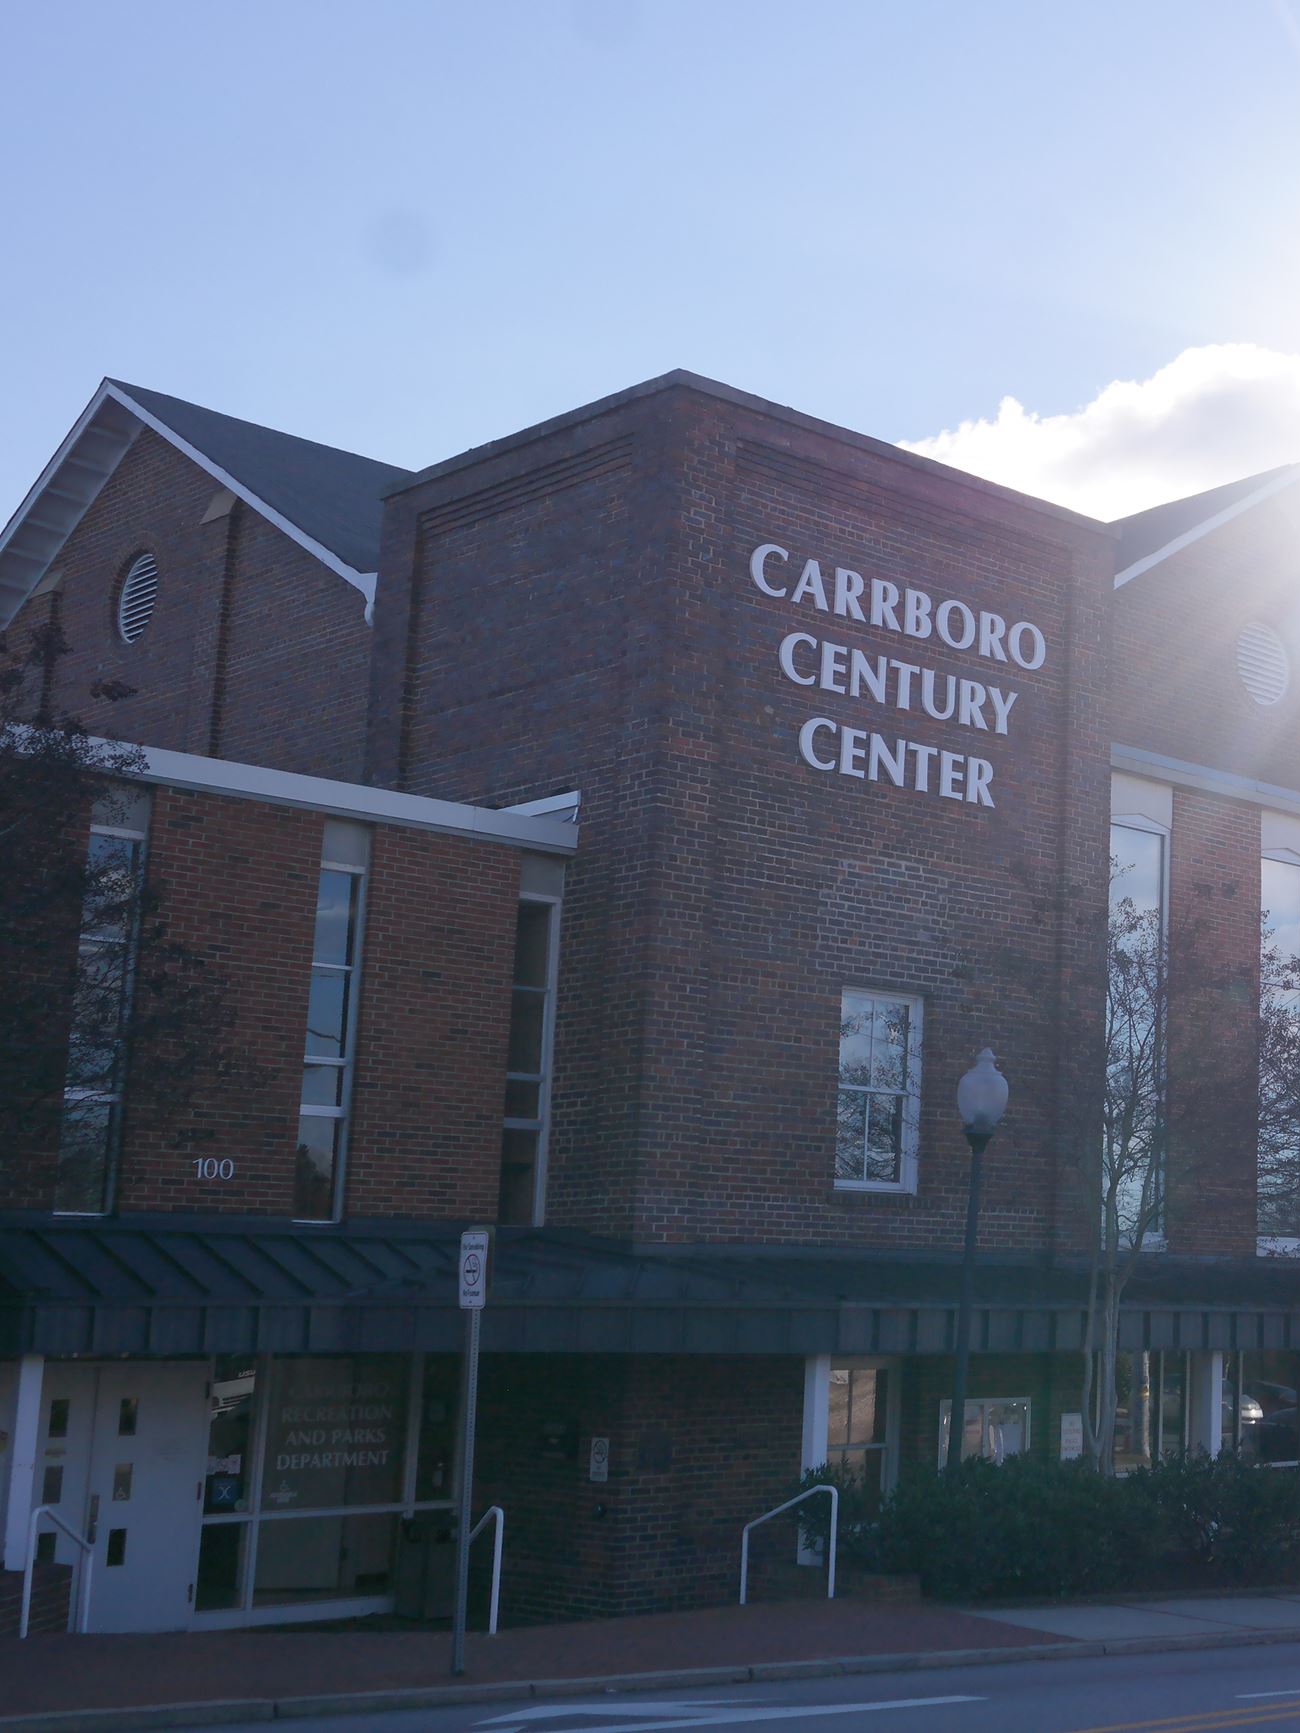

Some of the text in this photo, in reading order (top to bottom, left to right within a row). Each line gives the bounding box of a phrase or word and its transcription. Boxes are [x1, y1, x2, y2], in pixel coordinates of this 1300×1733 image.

[750, 543, 1046, 670] CARRBORO
[779, 632, 1018, 735] CENTURY
[799, 717, 995, 809] CENTER
[192, 1157, 234, 1180] 100
[281, 1404, 393, 1424] RECREATION
[286, 1427, 386, 1446] AND PARKS
[276, 1449, 391, 1471] DEPARTMENT
